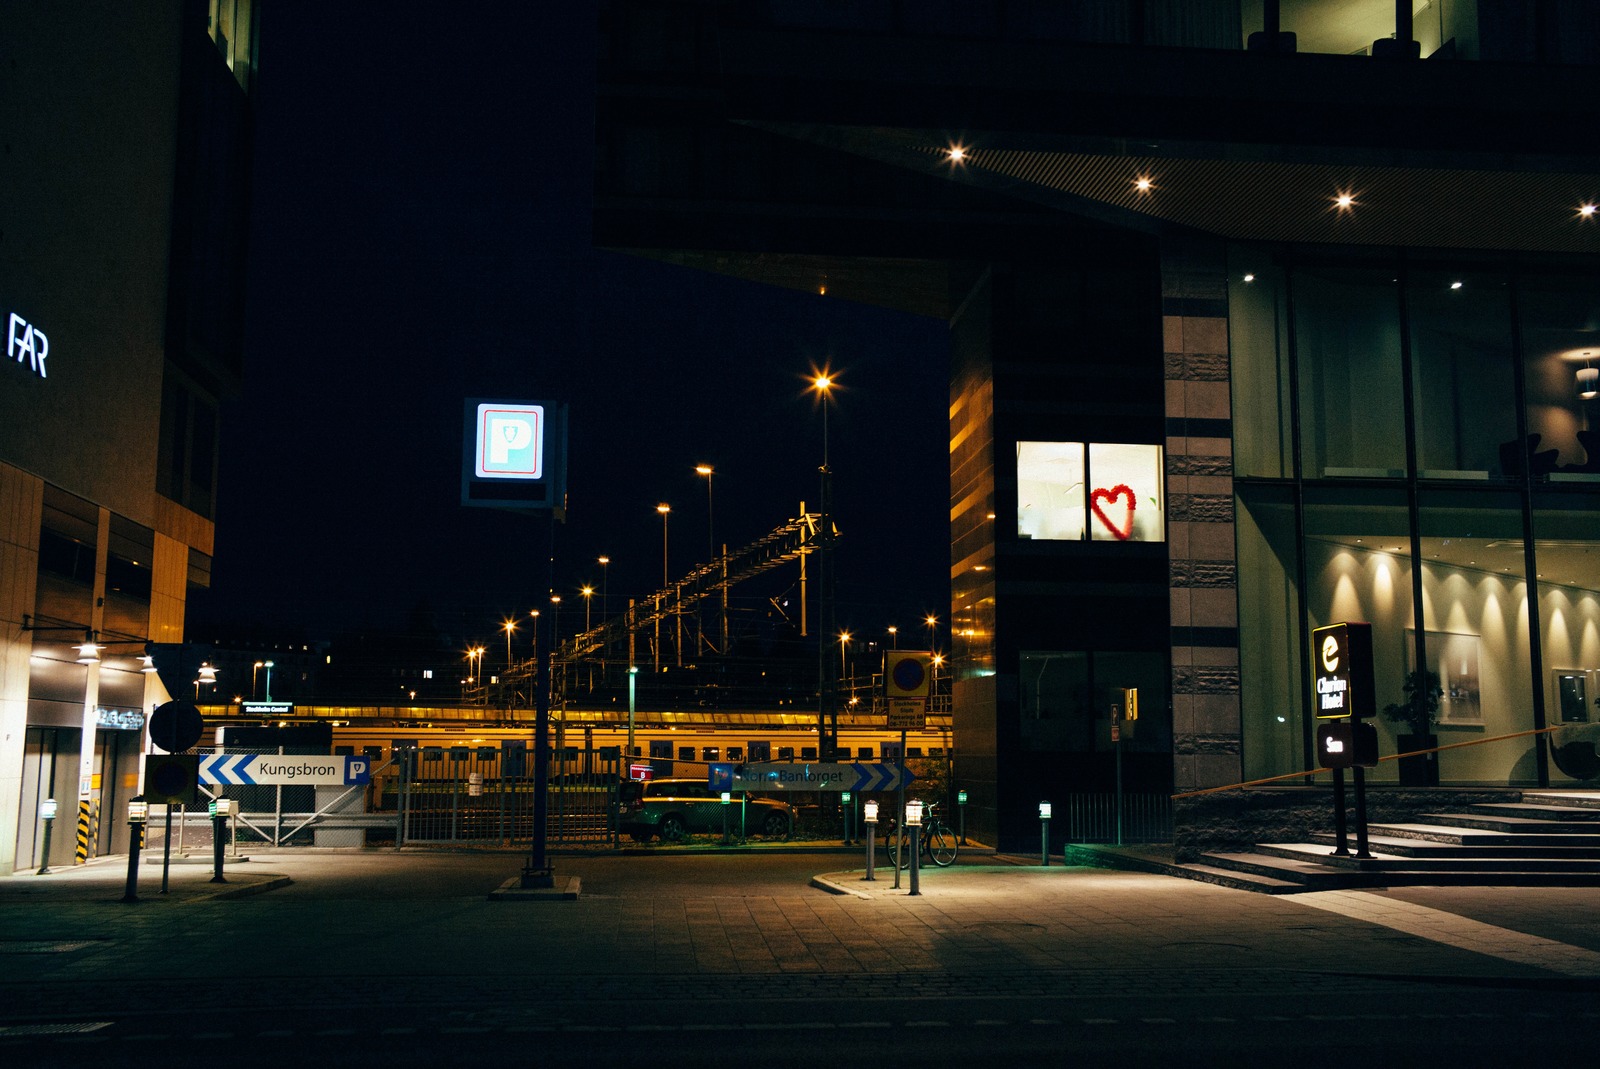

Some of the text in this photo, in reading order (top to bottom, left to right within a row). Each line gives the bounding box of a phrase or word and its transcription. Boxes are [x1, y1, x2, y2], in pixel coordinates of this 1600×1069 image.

[7, 312, 49, 378] FAR
[490, 418, 532, 464] P
[1317, 676, 1346, 694] Clarion
[1322, 692, 1343, 709] Hotel
[259, 761, 366, 780] Kungsbron P
[779, 770, 843, 786] Bantorget
